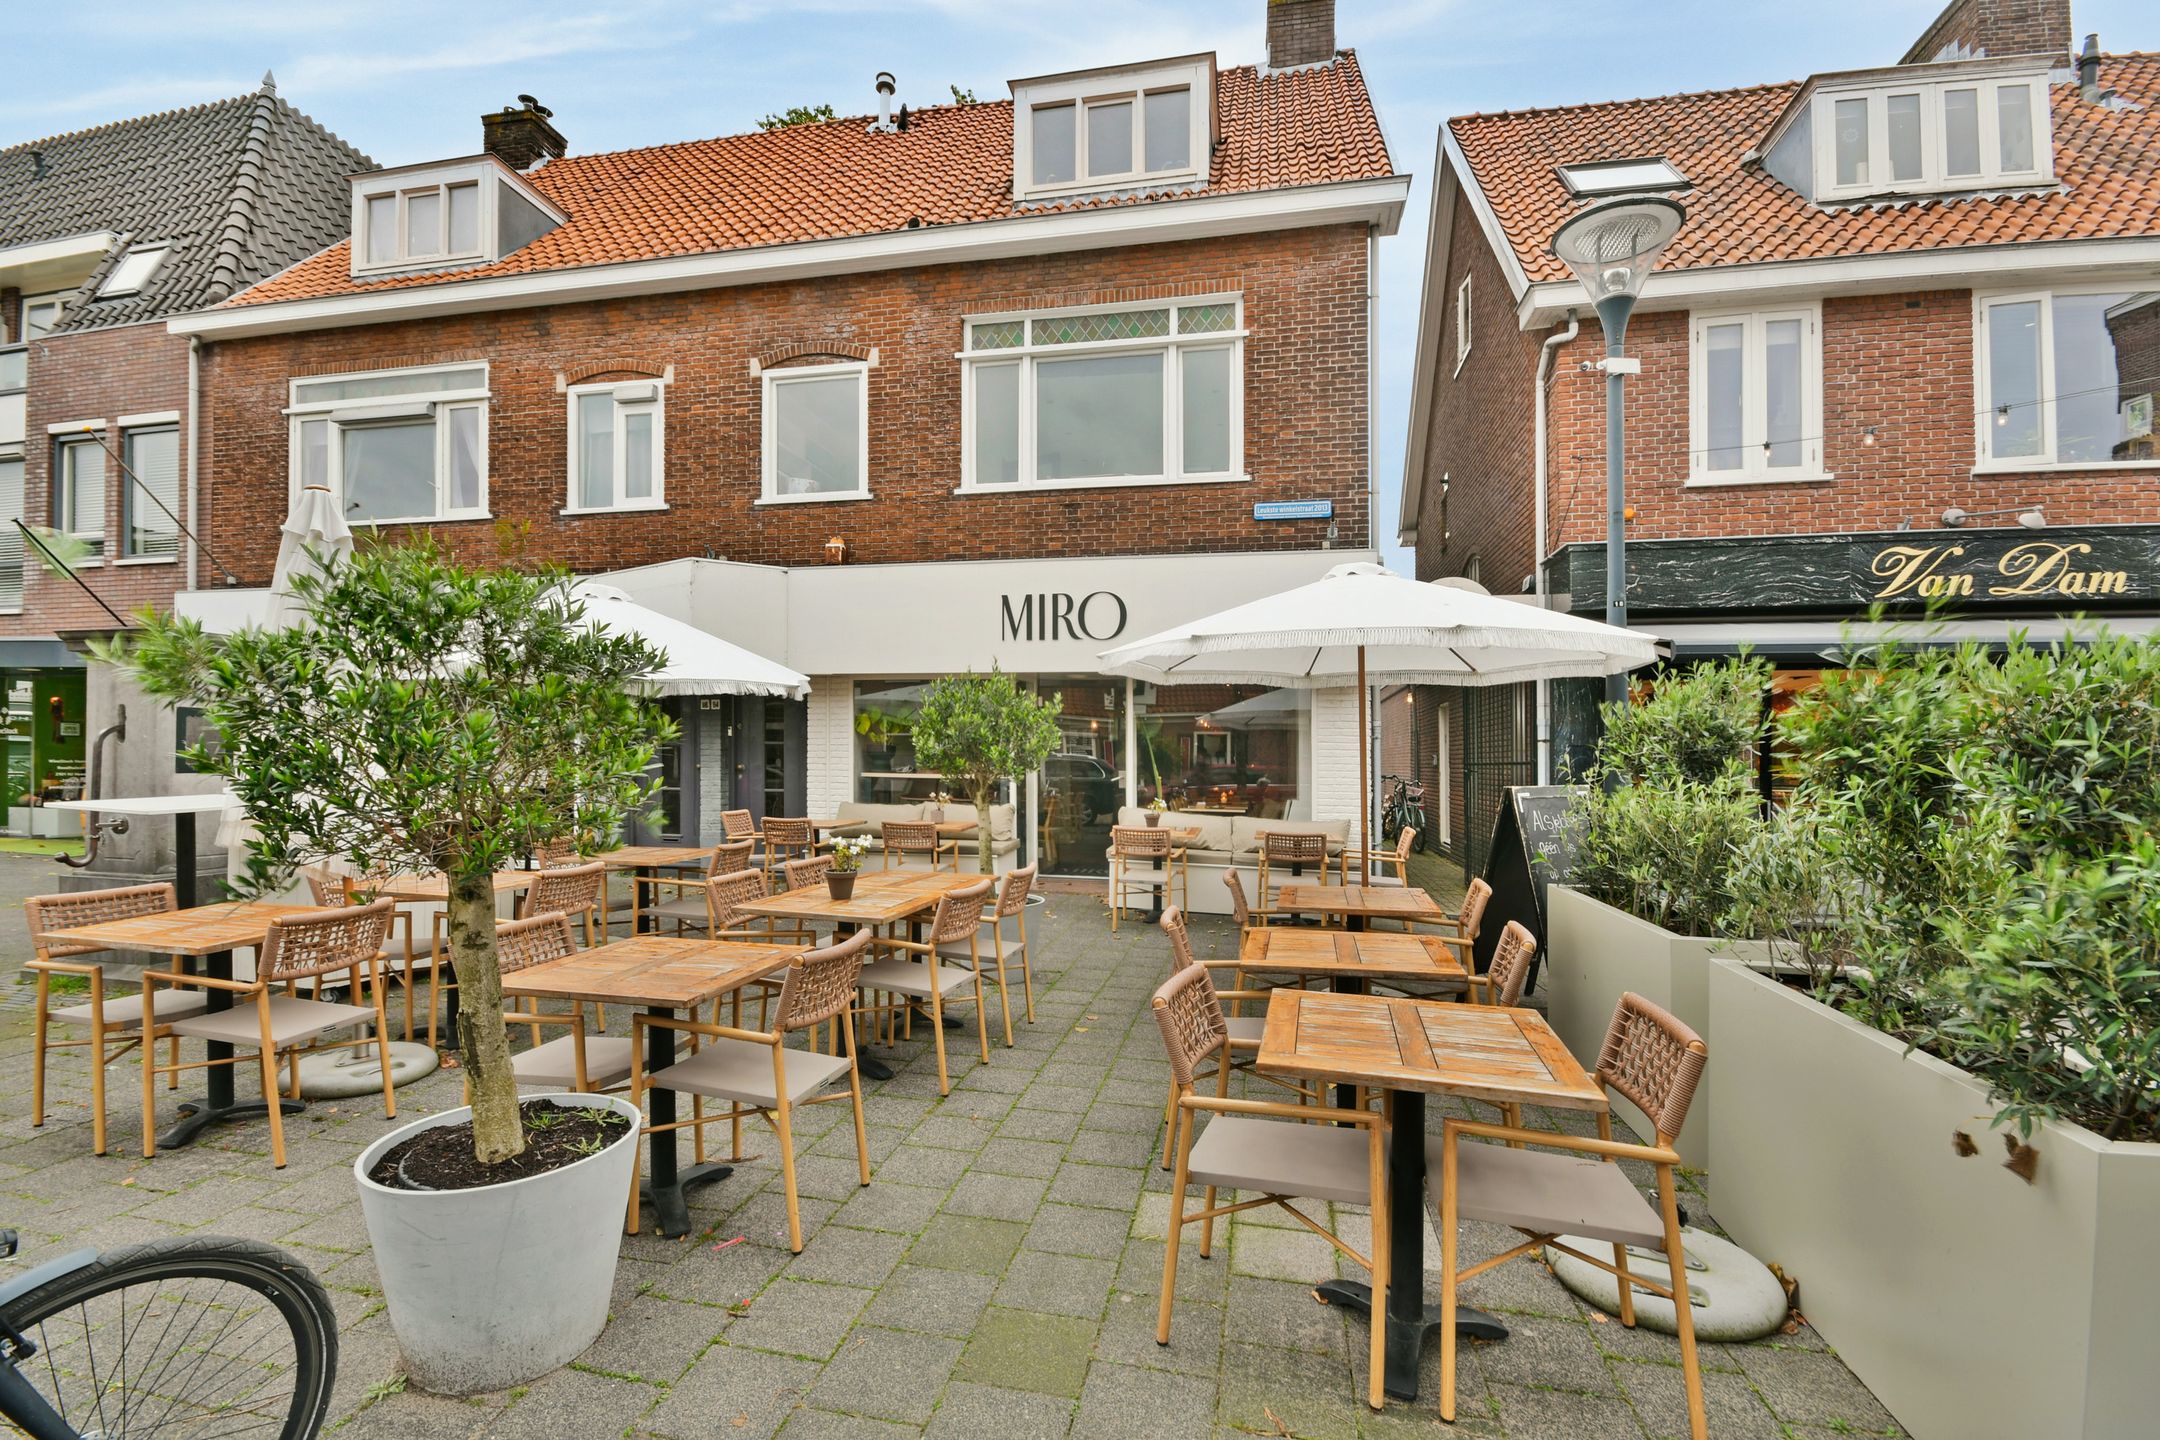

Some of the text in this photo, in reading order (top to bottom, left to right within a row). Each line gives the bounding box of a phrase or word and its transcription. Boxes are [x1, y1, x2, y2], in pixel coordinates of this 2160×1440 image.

[1257, 504, 1328, 514] Leukste winkelstraat 2013
[1871, 542, 2128, 598] Van Dam
[1001, 591, 1127, 641] MIRO
